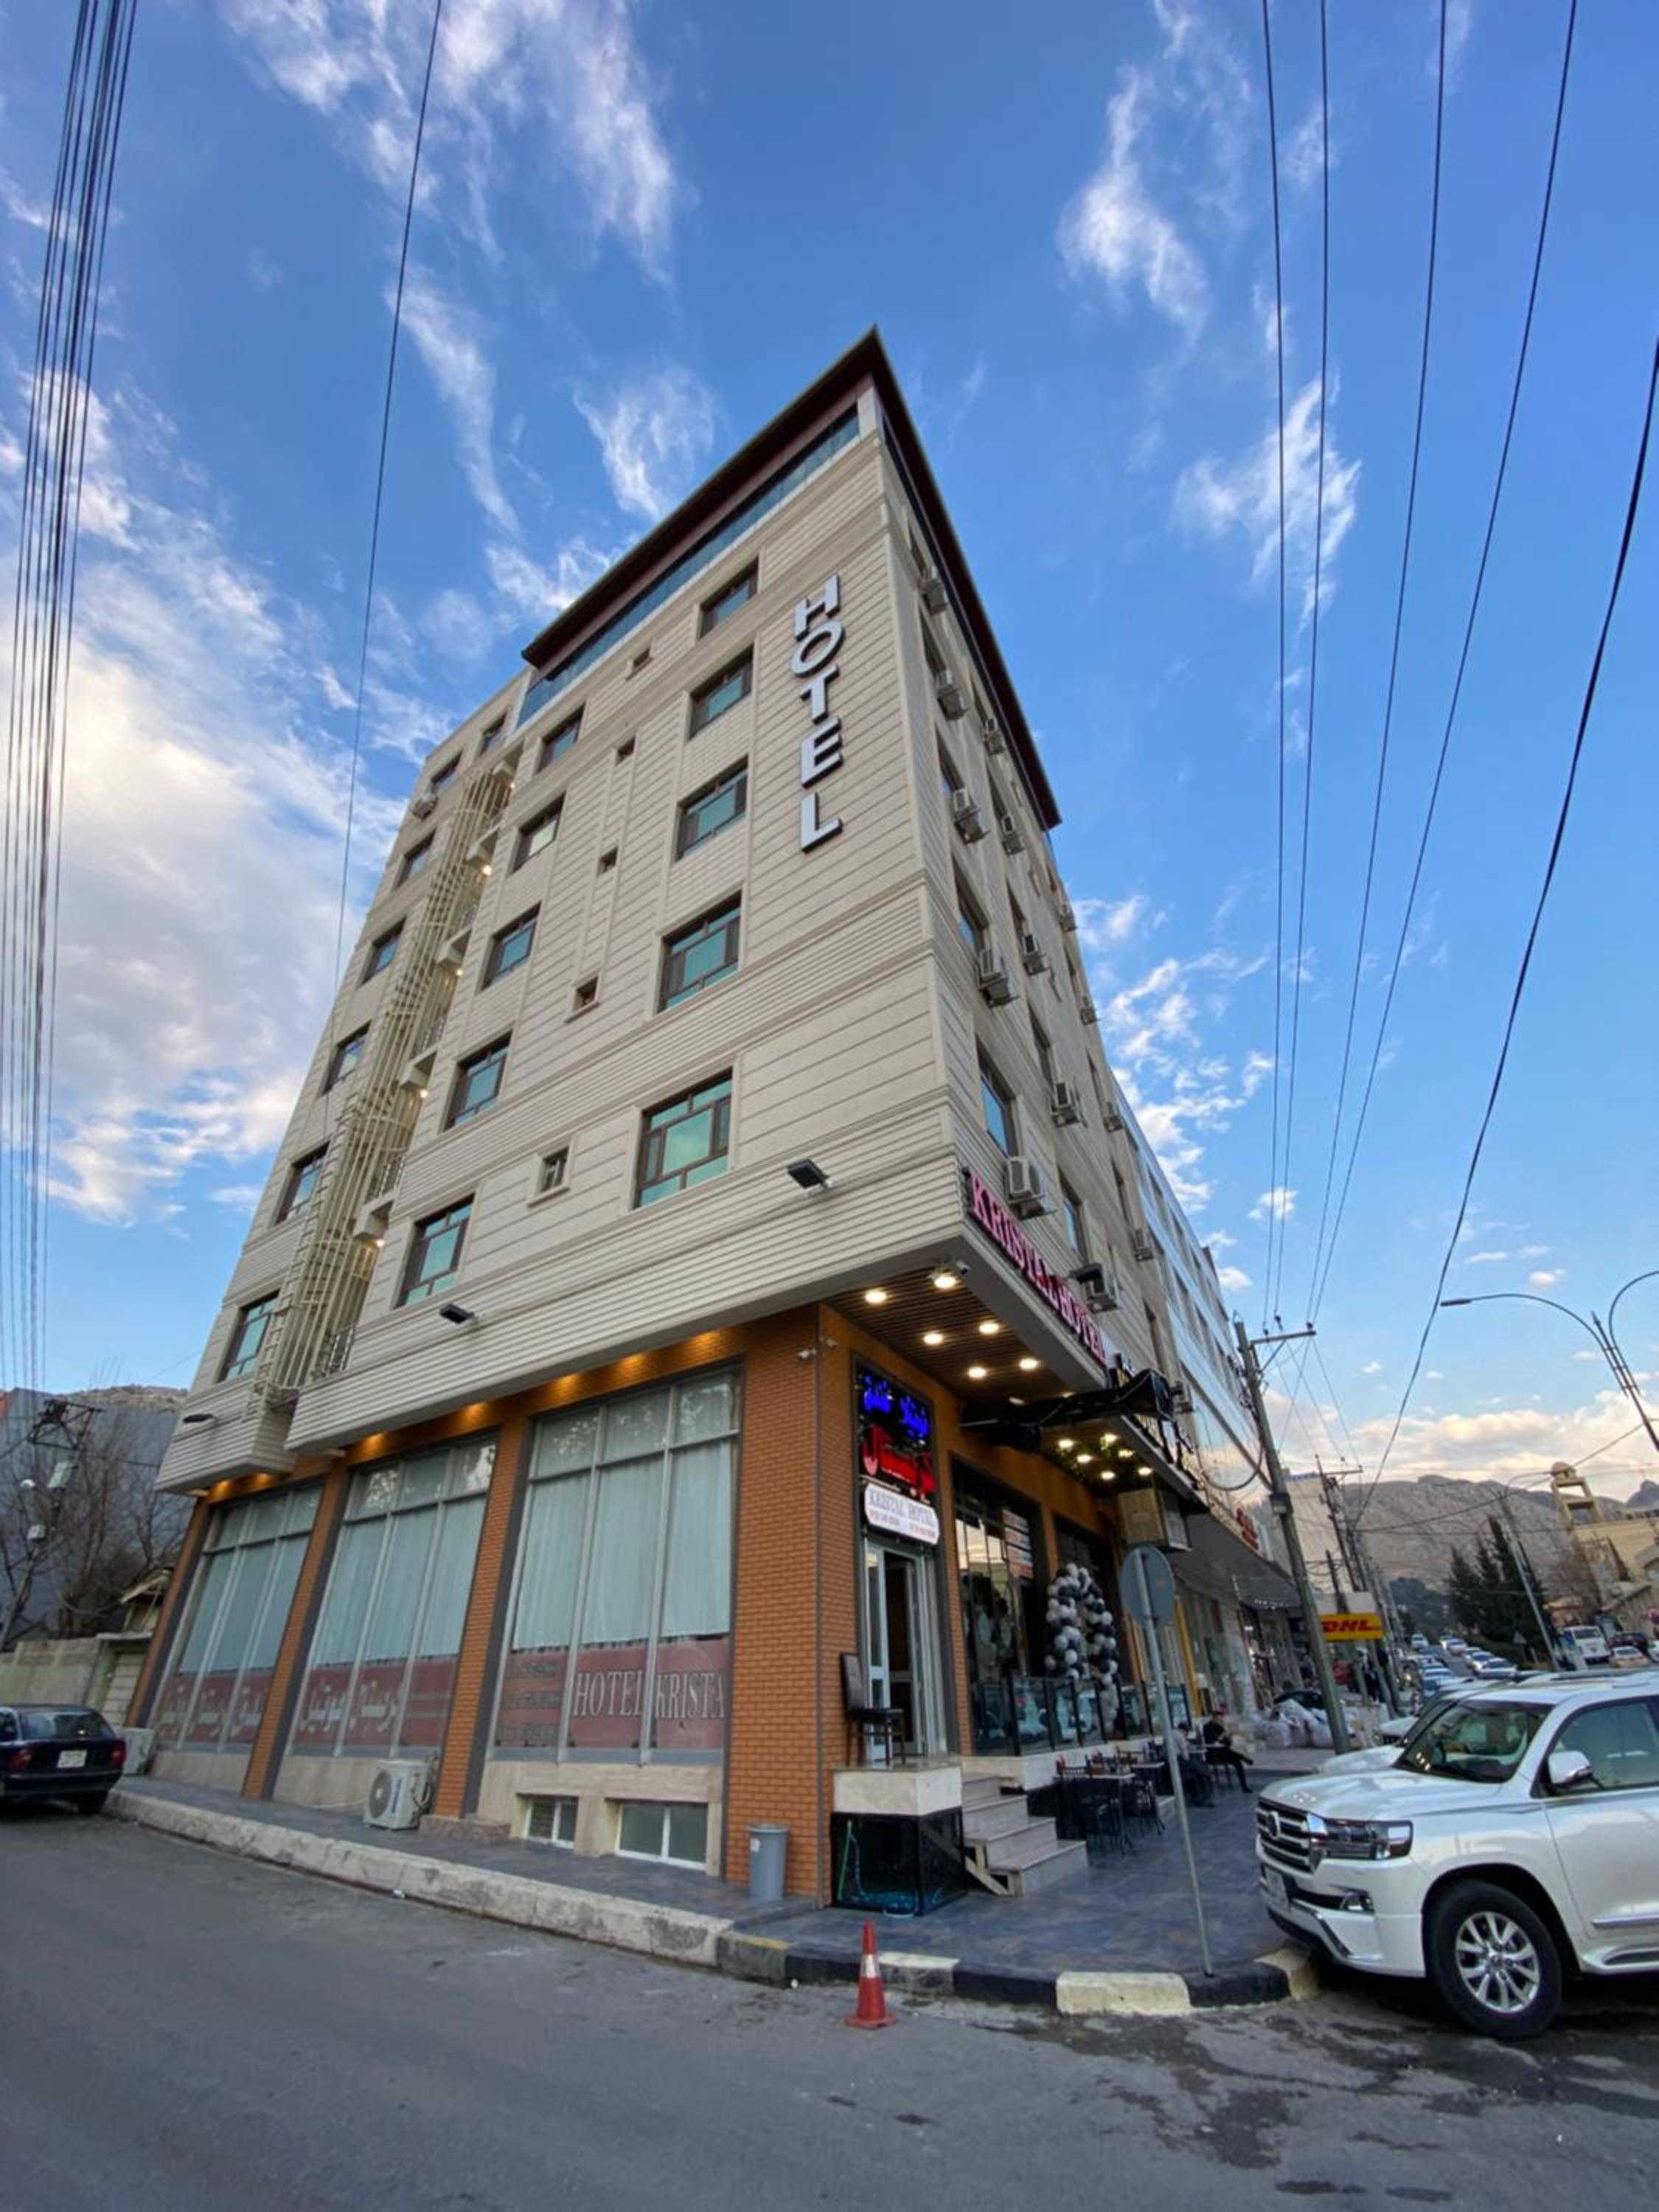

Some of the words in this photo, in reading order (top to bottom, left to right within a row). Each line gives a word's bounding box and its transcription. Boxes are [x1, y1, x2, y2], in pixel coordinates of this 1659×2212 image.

[791, 574, 846, 854] HOTEL
[967, 1166, 1060, 1311] KRISTAL
[1321, 1619, 1370, 1632] DHL
[573, 1669, 644, 1717] HOTEL
